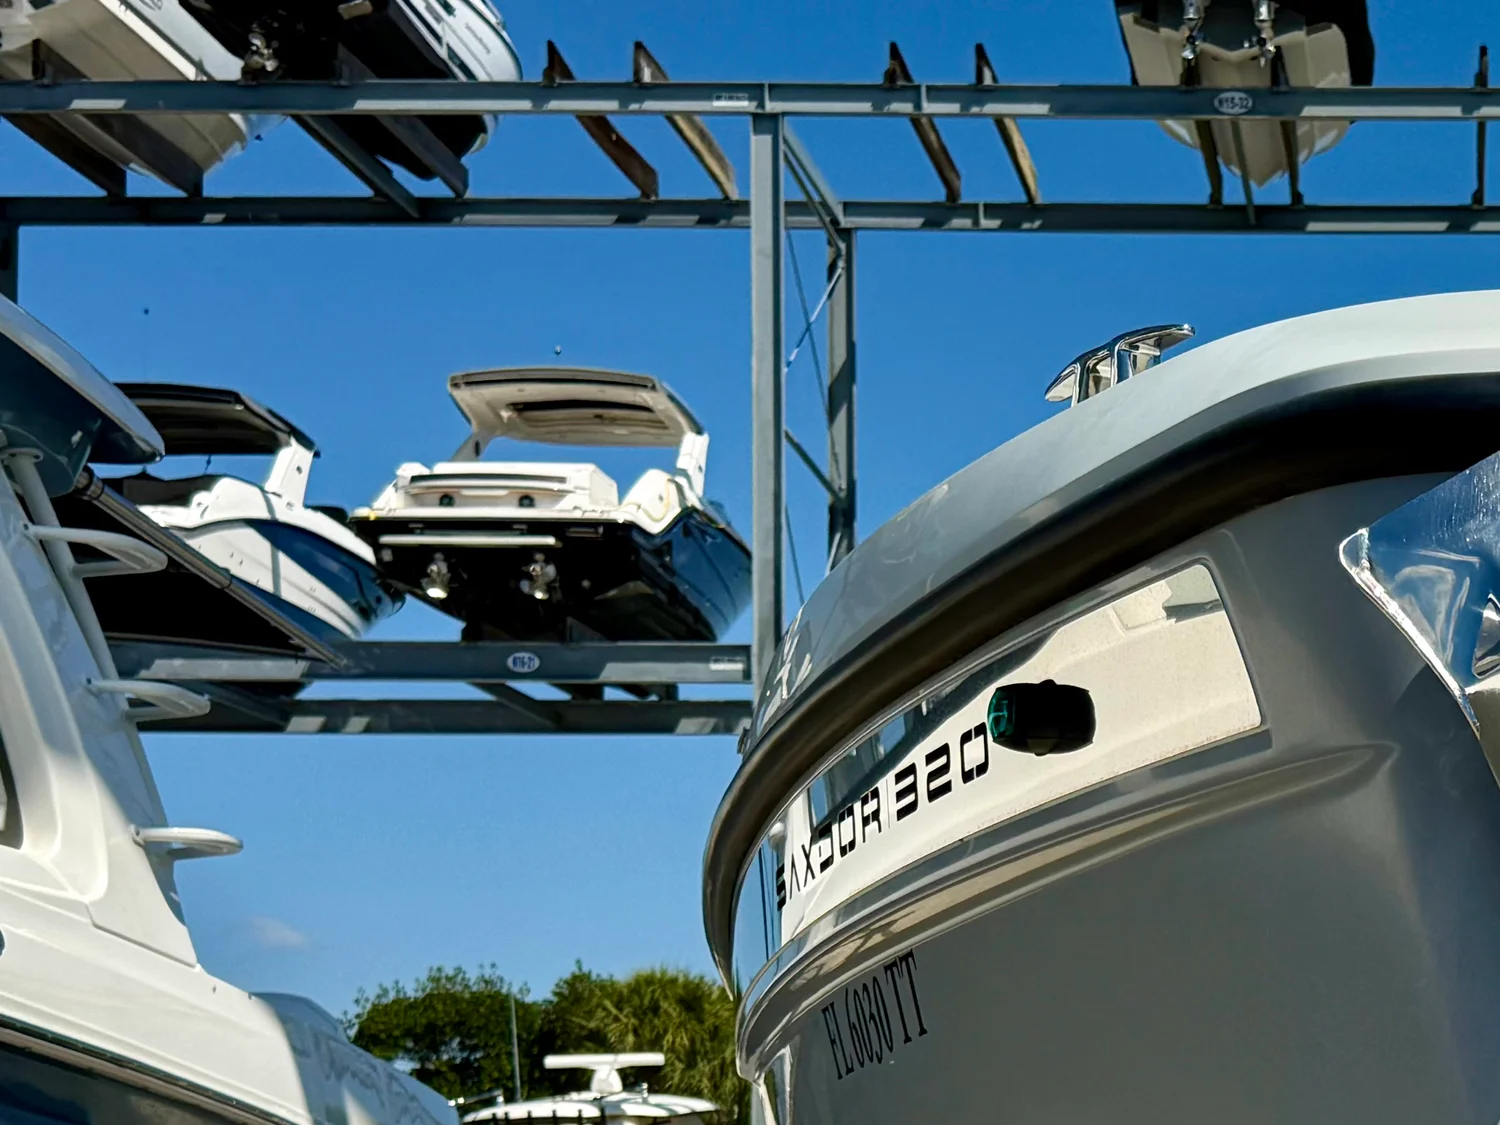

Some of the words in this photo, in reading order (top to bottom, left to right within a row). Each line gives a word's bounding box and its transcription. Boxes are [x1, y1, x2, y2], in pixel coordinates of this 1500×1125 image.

[776, 786, 882, 911] SAXDOR
[894, 721, 990, 822] 320
[821, 1001, 855, 1080] FL
[845, 975, 894, 1068] 6030
[883, 948, 928, 1045] TT
